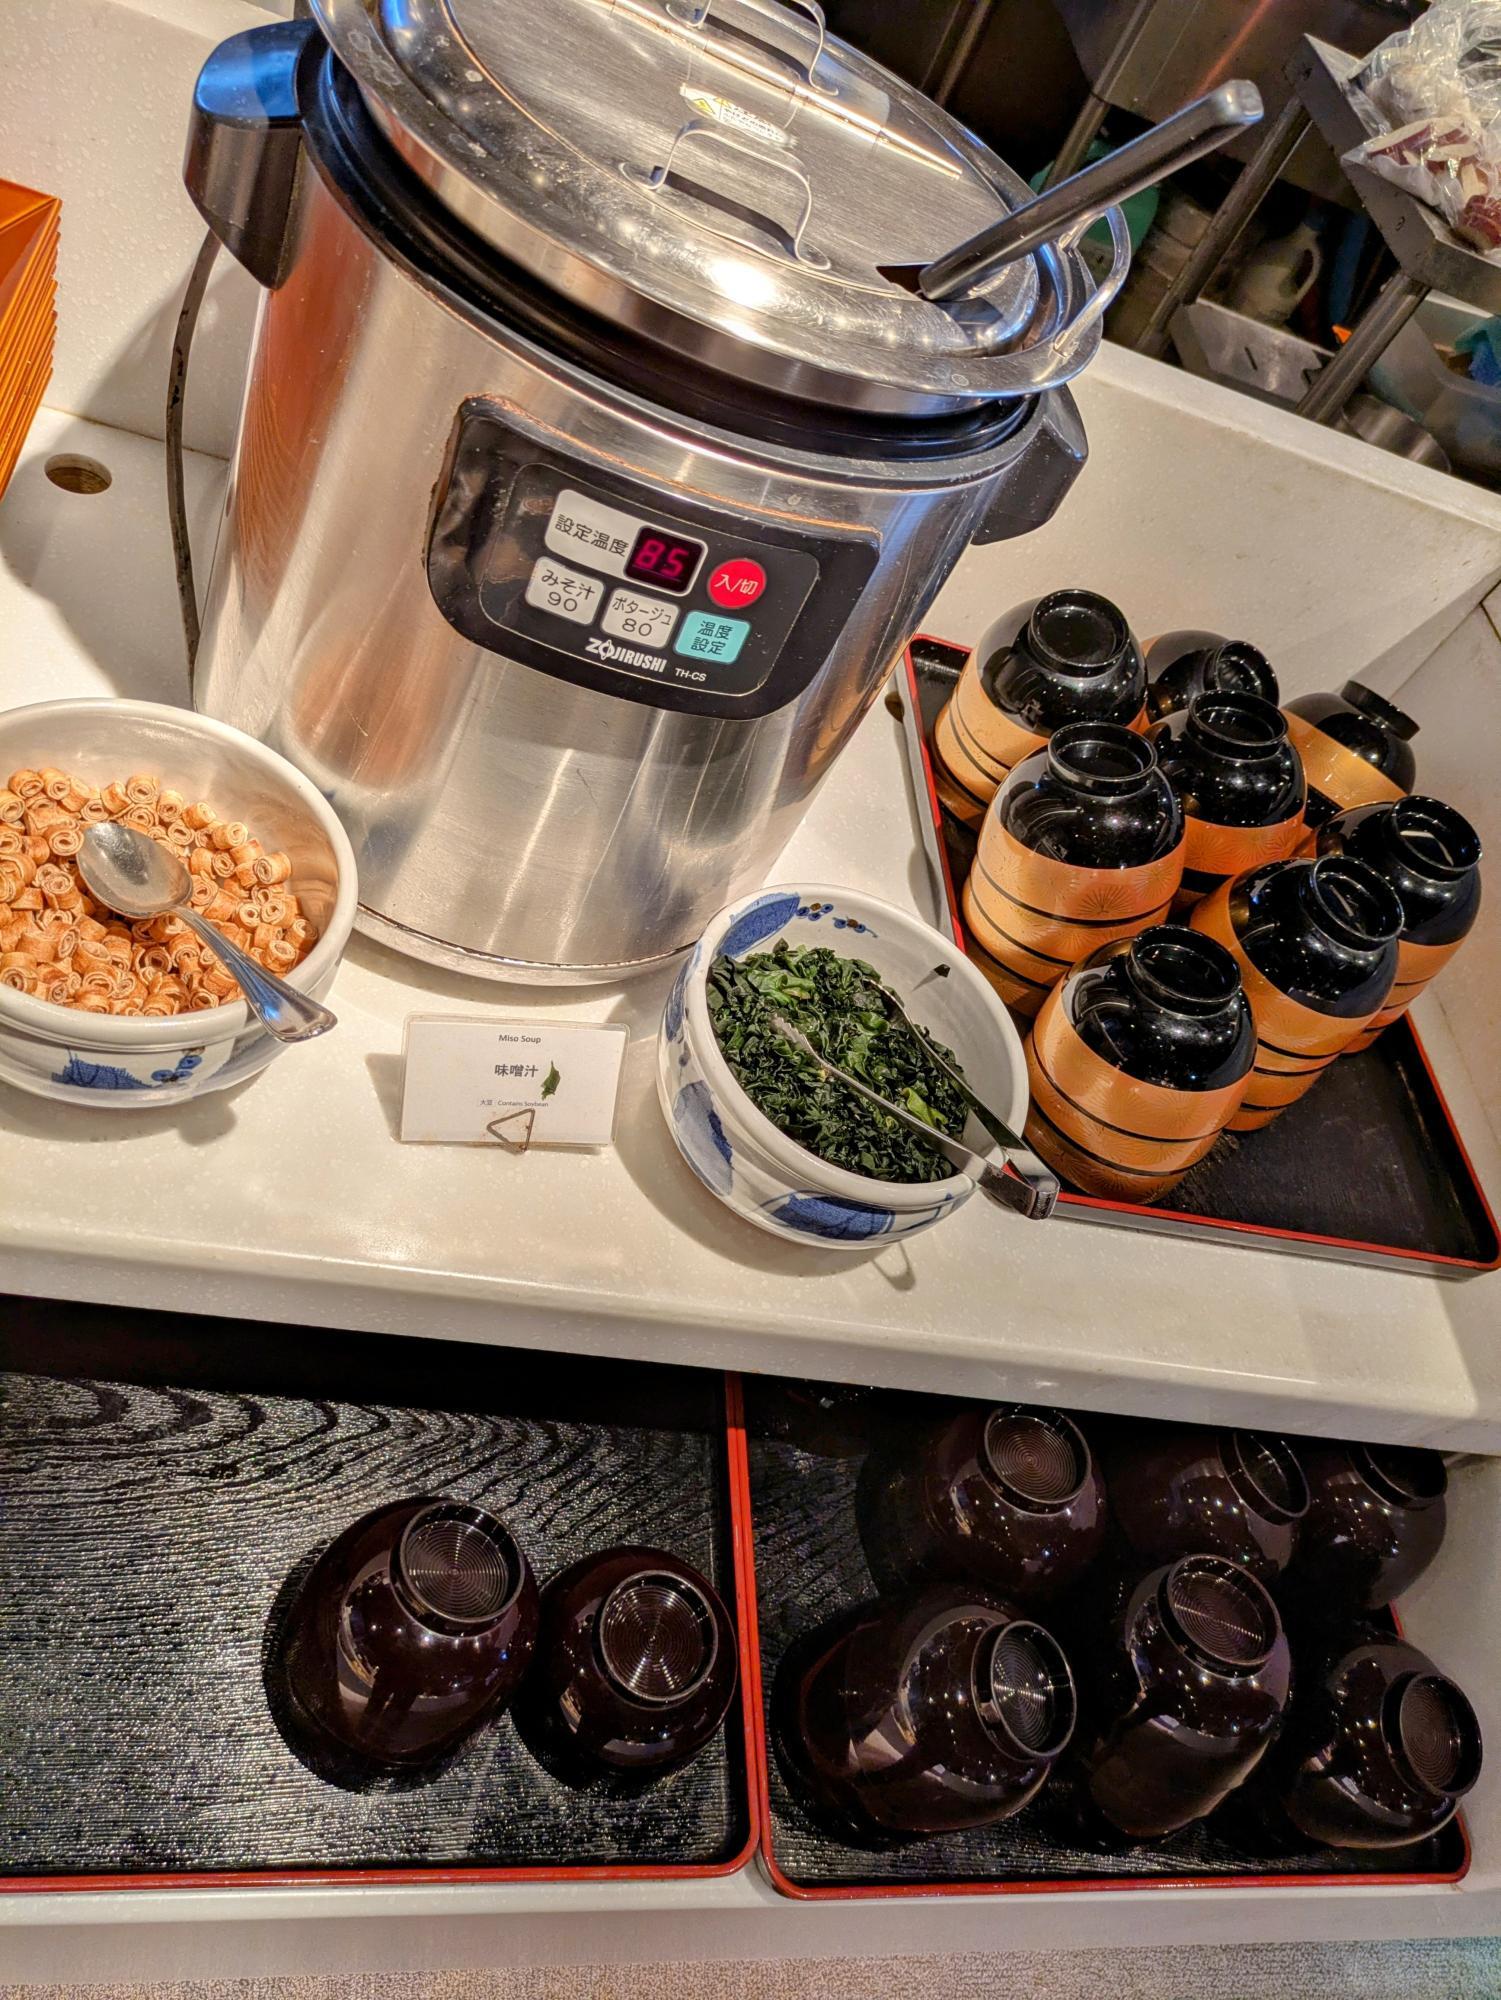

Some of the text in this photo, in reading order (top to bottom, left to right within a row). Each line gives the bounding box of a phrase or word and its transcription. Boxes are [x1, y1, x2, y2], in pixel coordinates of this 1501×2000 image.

[554, 514, 630, 558] 設定温度
[637, 539, 689, 577] 85
[540, 569, 596, 600] みそ汁
[713, 571, 759, 596] 入/切
[547, 590, 578, 614] 90
[611, 595, 673, 627] ポタージュ
[621, 618, 653, 637] 80
[697, 620, 733, 641] 温度
[586, 637, 667, 673] ZOJIRUSHI
[690, 637, 728, 657] 設定
[674, 667, 707, 682] TH-CS
[498, 1034, 541, 1044] Miso Soup
[495, 1064, 539, 1077] 味噌汁
